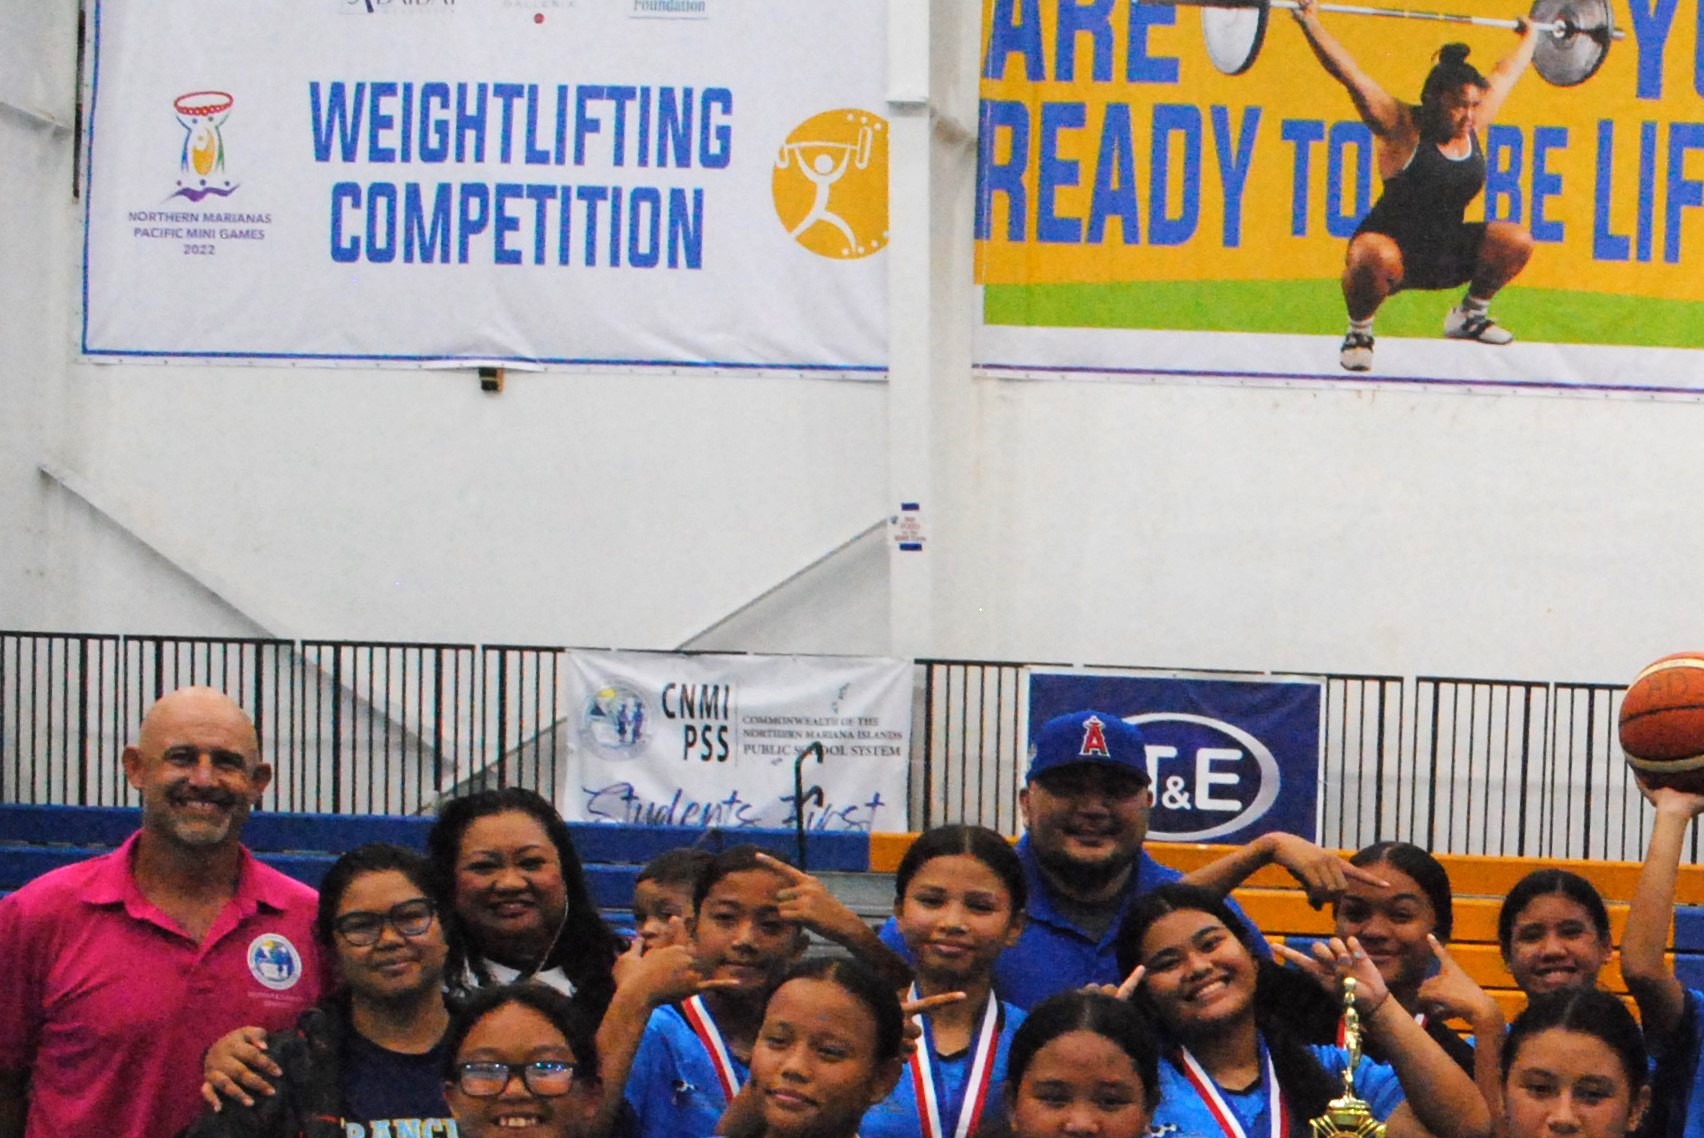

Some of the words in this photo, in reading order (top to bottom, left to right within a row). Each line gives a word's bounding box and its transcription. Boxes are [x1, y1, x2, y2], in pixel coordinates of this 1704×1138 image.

[983, 0, 1179, 82] ARE
[308, 79, 734, 169] WEIGHTLIFTING
[973, 100, 1261, 247] READY
[1282, 120, 1373, 238] TO
[1486, 125, 1568, 242] BE
[128, 211, 199, 222] NORTHERN
[203, 212, 272, 224] MARIANAS
[134, 227, 184, 239] PACIFIC
[186, 228, 216, 239] MINI
[219, 229, 266, 240] GAMES
[328, 180, 705, 270] COMPETITION
[183, 244, 216, 255] 2022
[661, 682, 731, 721] CNMI
[742, 716, 838, 727] COMMONWEALTH
[857, 717, 880, 727] THE
[743, 728, 803, 739] NORTHERN
[805, 729, 856, 739] MARIANA
[857, 730, 903, 740] ISLANDS
[1079, 715, 1111, 758] A
[683, 724, 731, 763] PSS
[743, 743, 791, 756] PUBLIC
[851, 744, 902, 758] SYSTEM
[1143, 744, 1244, 812] T&E
